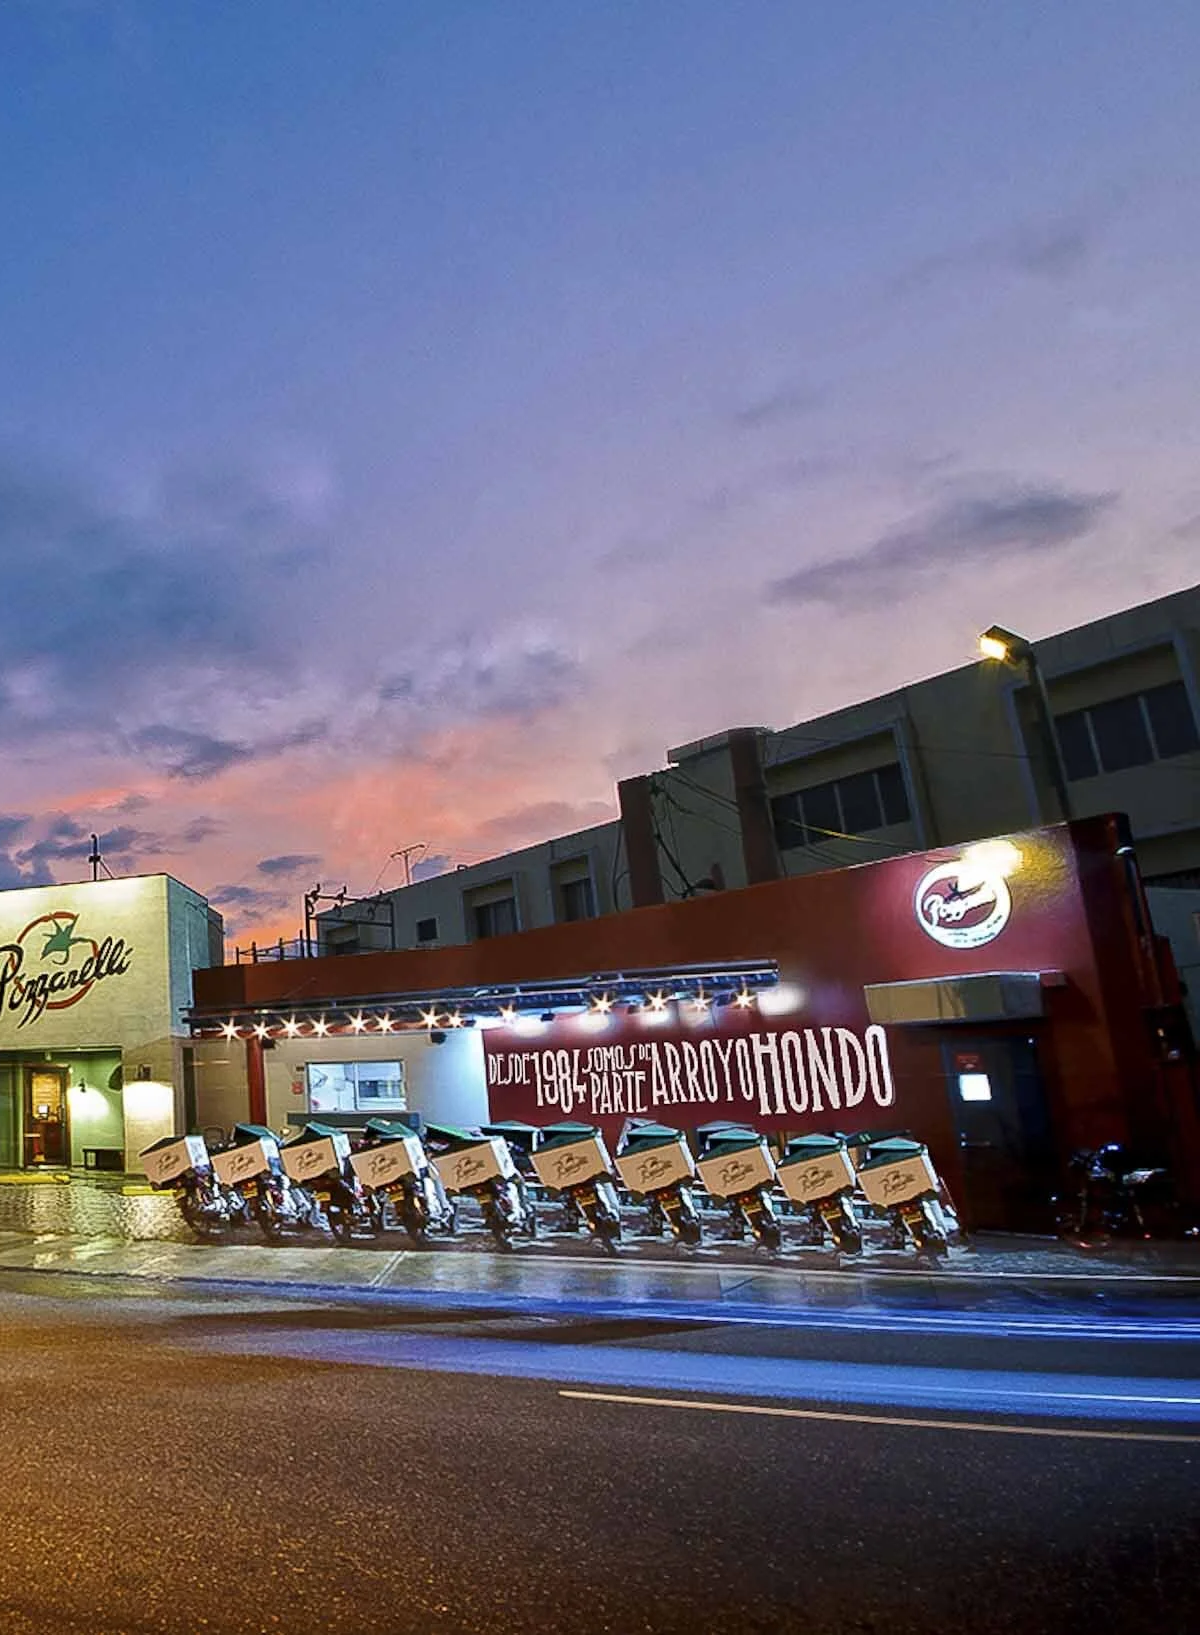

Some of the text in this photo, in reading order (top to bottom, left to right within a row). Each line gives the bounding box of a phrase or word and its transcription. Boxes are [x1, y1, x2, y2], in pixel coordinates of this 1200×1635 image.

[487, 1052, 531, 1086] DESDE
[530, 1049, 587, 1114] 1984
[582, 1044, 637, 1074] SOMOS
[651, 1038, 754, 1106] ARROYO
[750, 1024, 894, 1116] HONDO
[589, 1070, 648, 1114] PARTE
